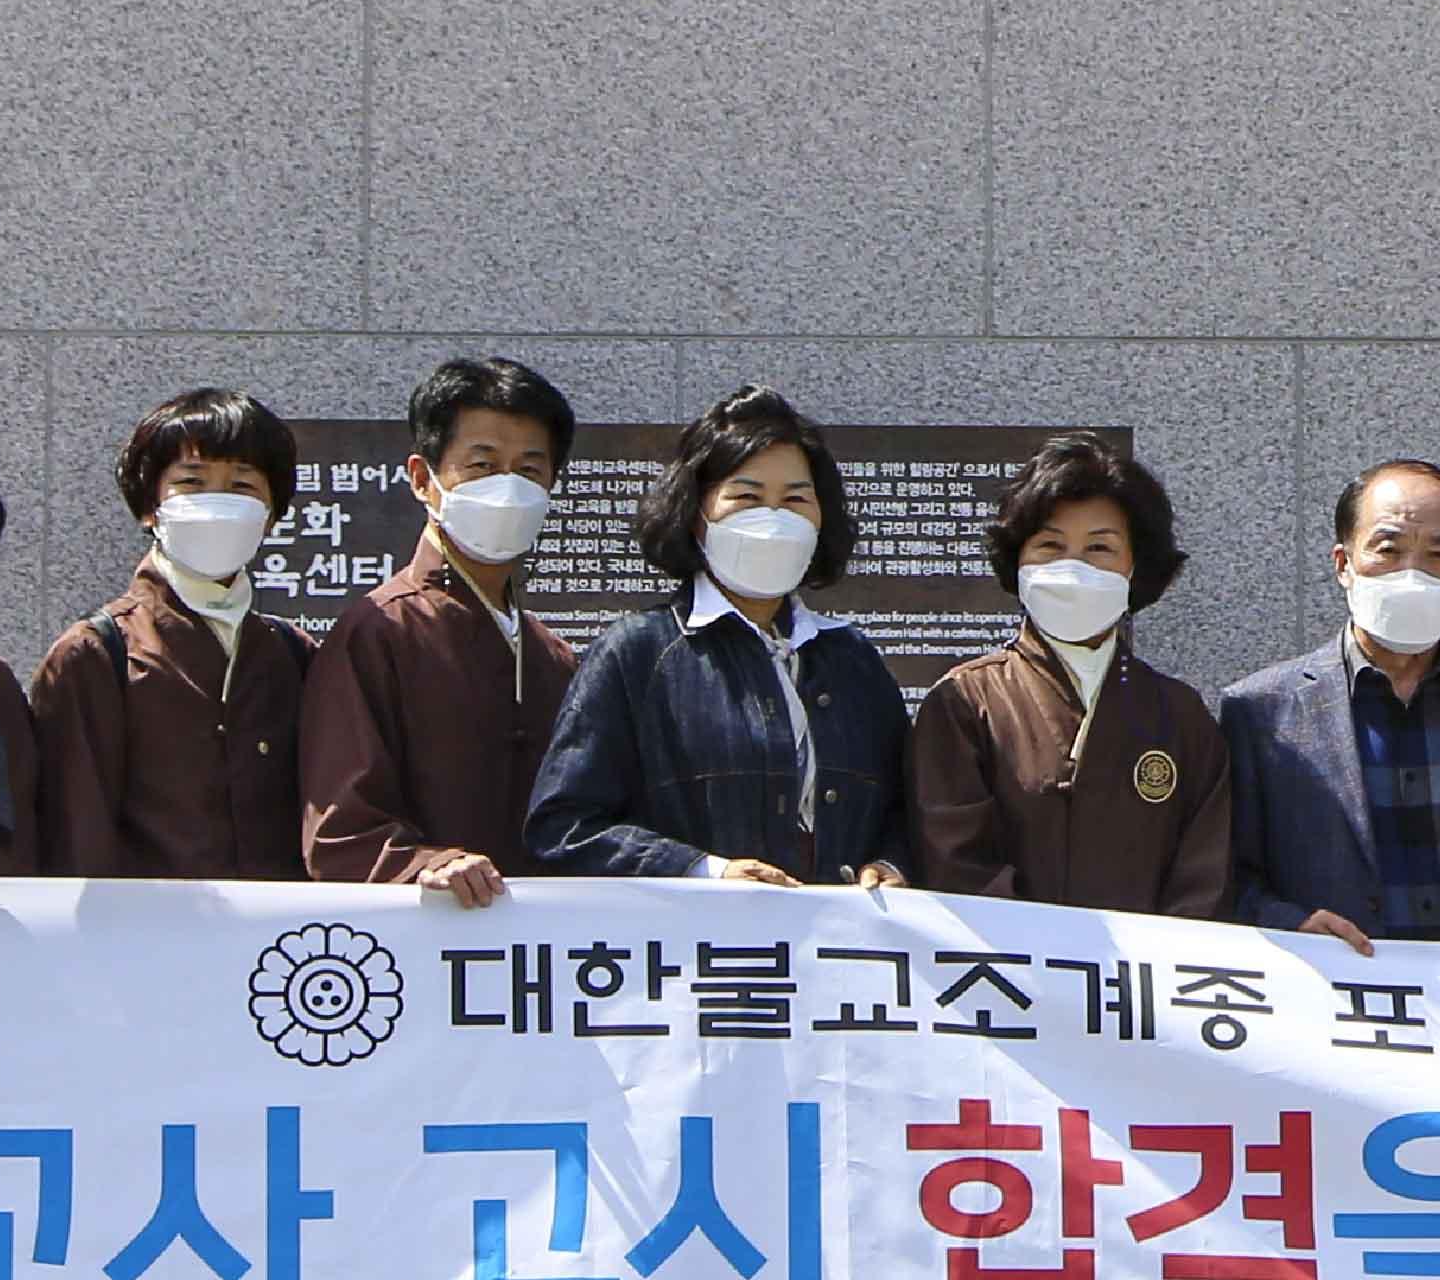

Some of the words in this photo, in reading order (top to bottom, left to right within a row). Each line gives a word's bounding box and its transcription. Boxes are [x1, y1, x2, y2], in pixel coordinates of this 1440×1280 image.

[910, 502, 947, 516] 그리고
[254, 553, 393, 598] 육센터
[440, 940, 1273, 1052] 대한불교조계종
